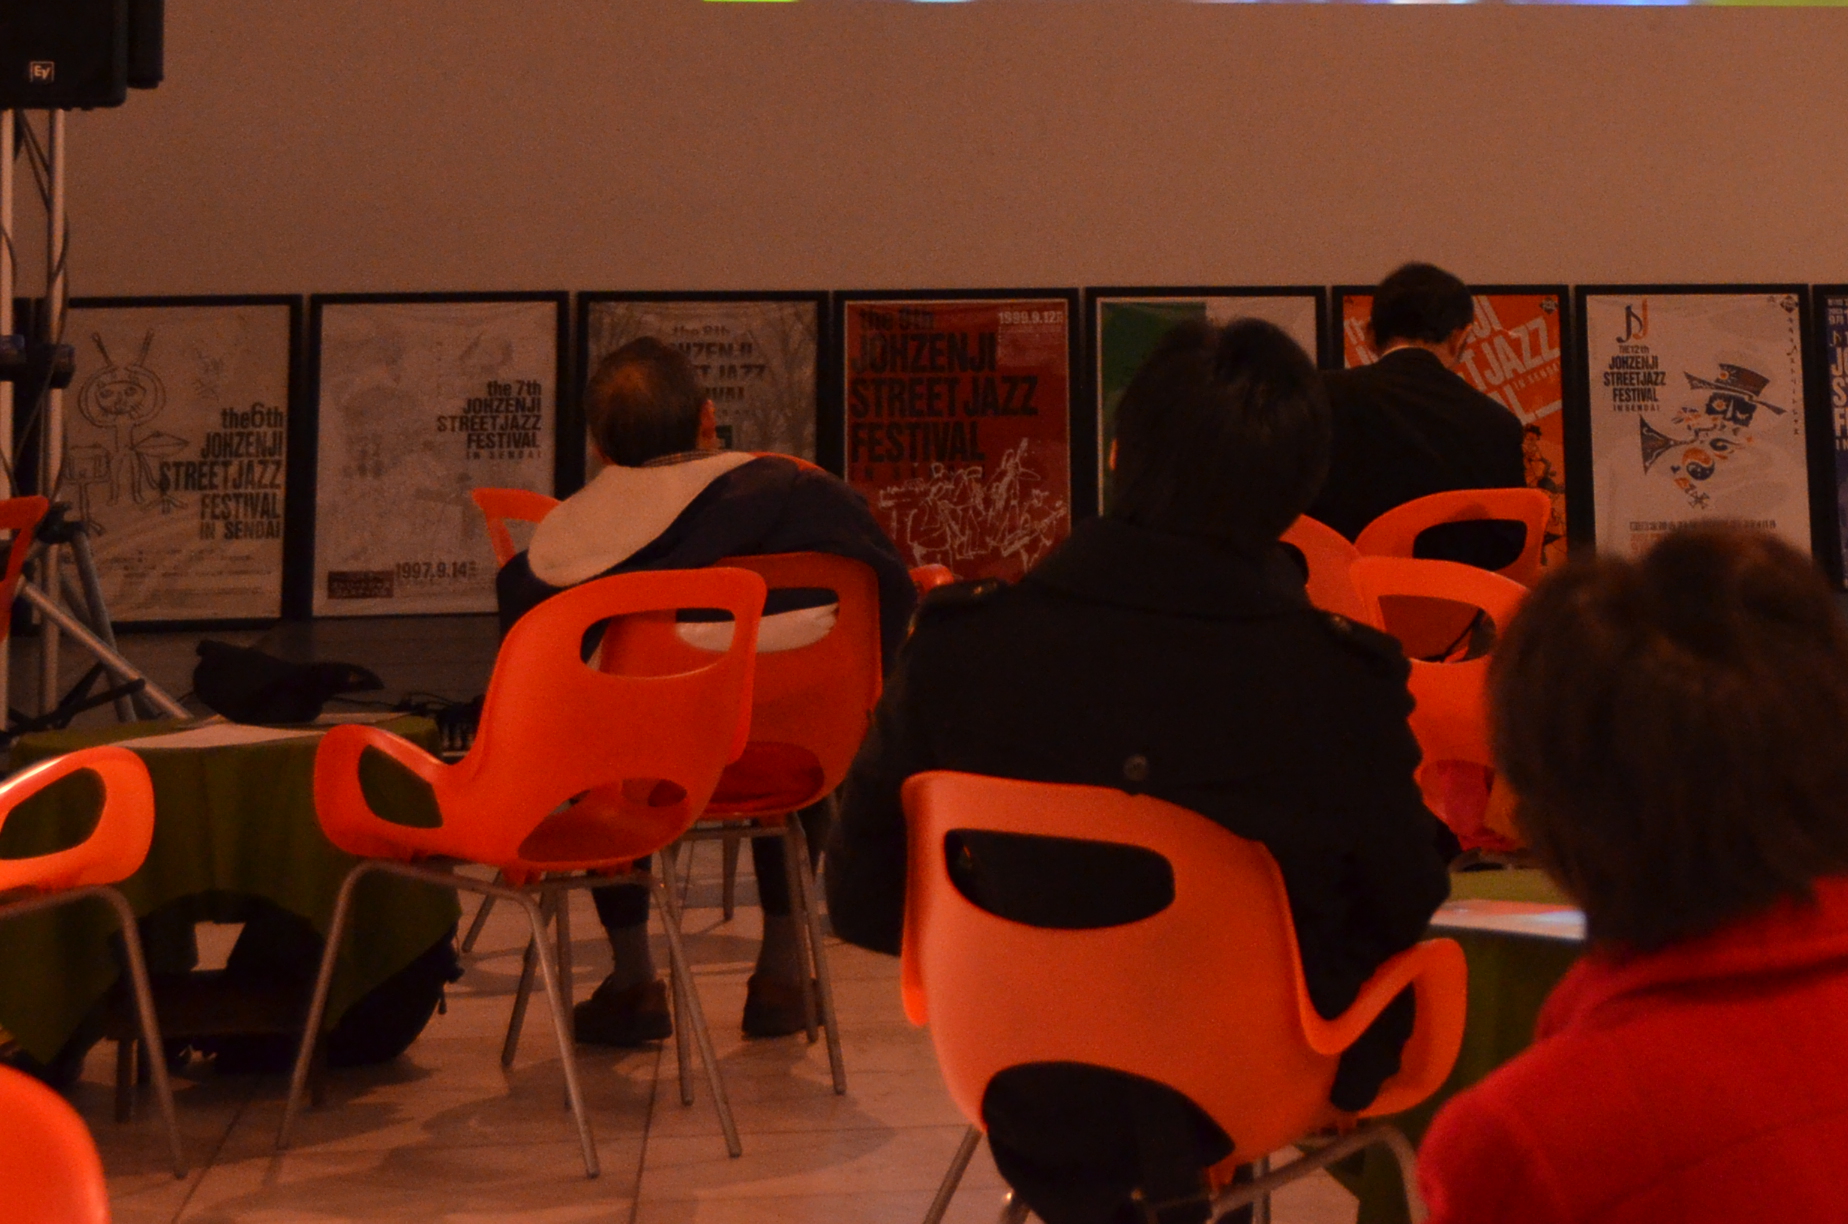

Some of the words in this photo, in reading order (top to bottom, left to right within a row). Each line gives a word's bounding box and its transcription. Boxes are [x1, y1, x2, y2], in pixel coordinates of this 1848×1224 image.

[852, 332, 997, 373] JOHZENJI
[1608, 355, 1659, 370] JOHZENJI
[487, 381, 511, 396] the
[516, 380, 541, 396] 7th
[1612, 388, 1658, 402] FESTIVAL
[463, 397, 541, 414] JOHZENJI
[201, 431, 283, 458] JOHZENJI
[466, 431, 540, 449] FESTIVAL
[852, 421, 986, 463] FESTIVAL
[200, 492, 281, 520] FESTIVAL
[200, 521, 216, 540] IN
[223, 520, 282, 540] SENDAI
